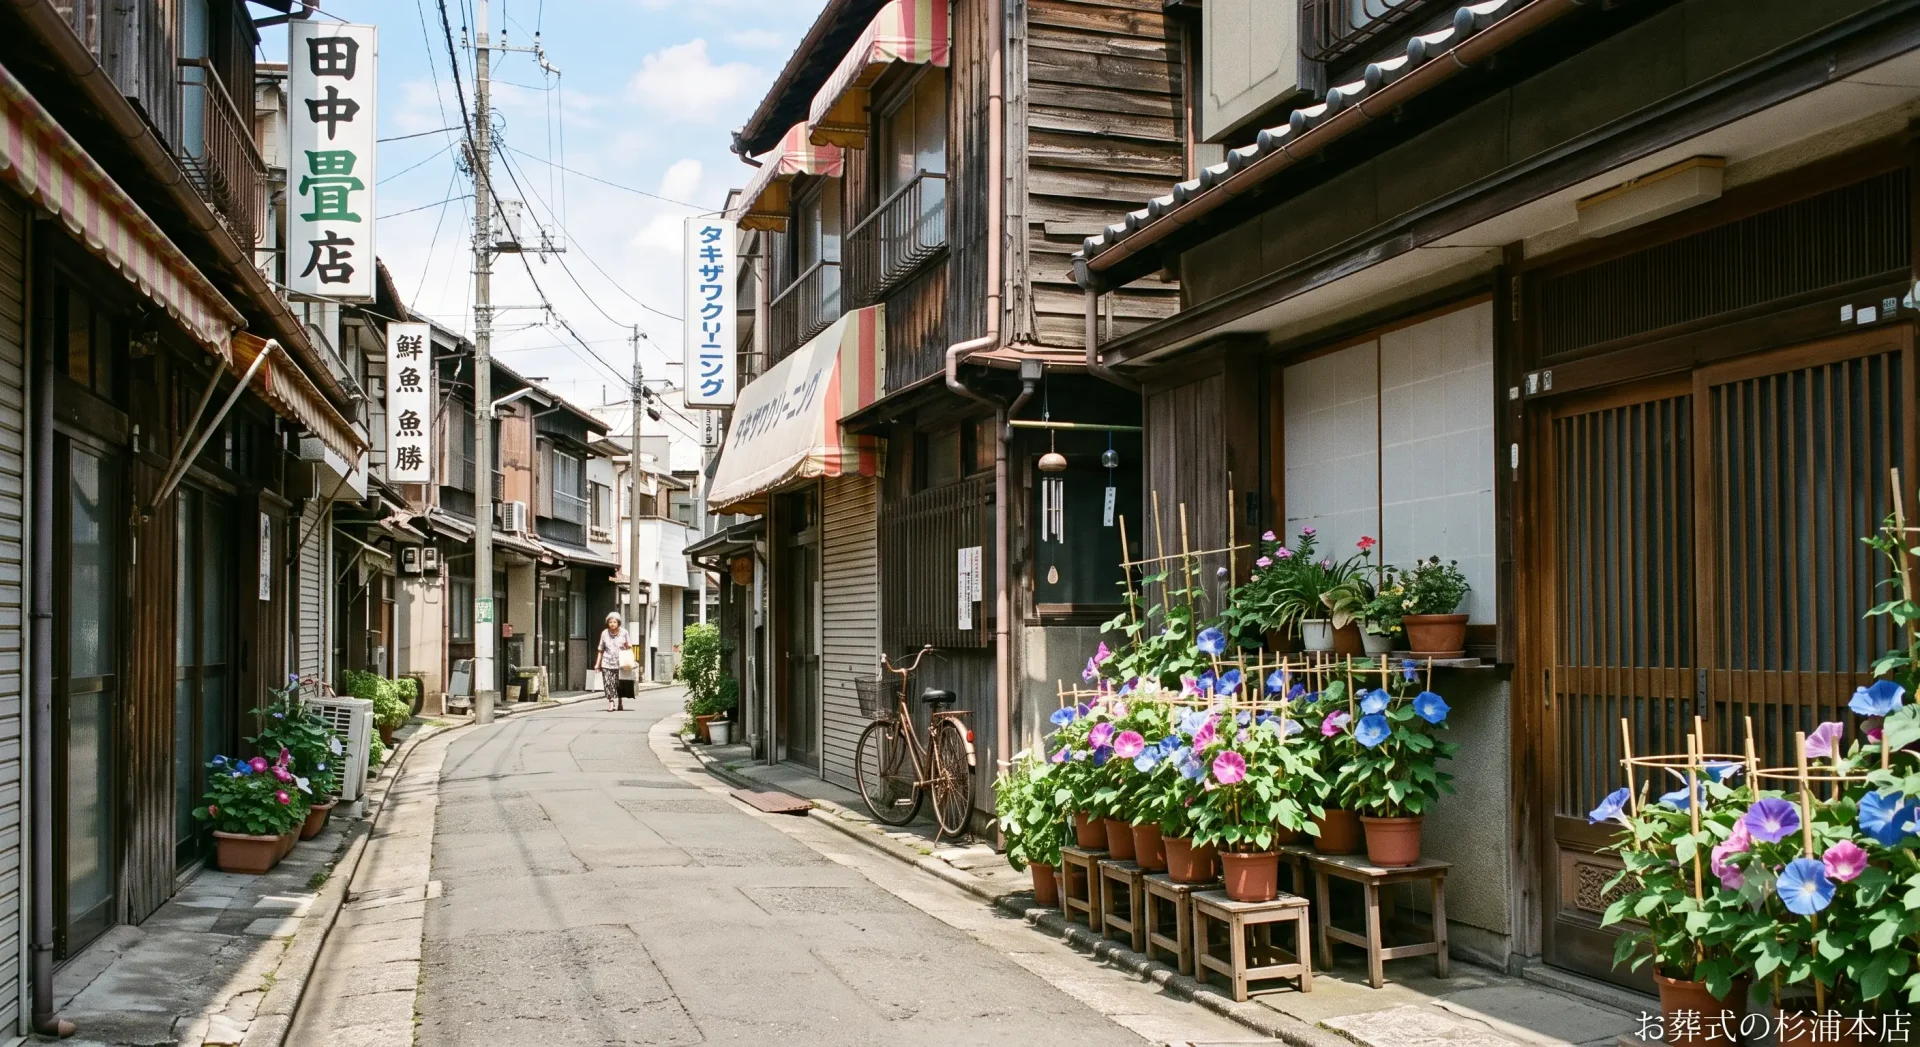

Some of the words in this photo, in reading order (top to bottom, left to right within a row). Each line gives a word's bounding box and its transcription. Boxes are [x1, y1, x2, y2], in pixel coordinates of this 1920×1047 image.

[298, 36, 365, 285] 田中畳店
[698, 225, 725, 397] タキザワクリーニング
